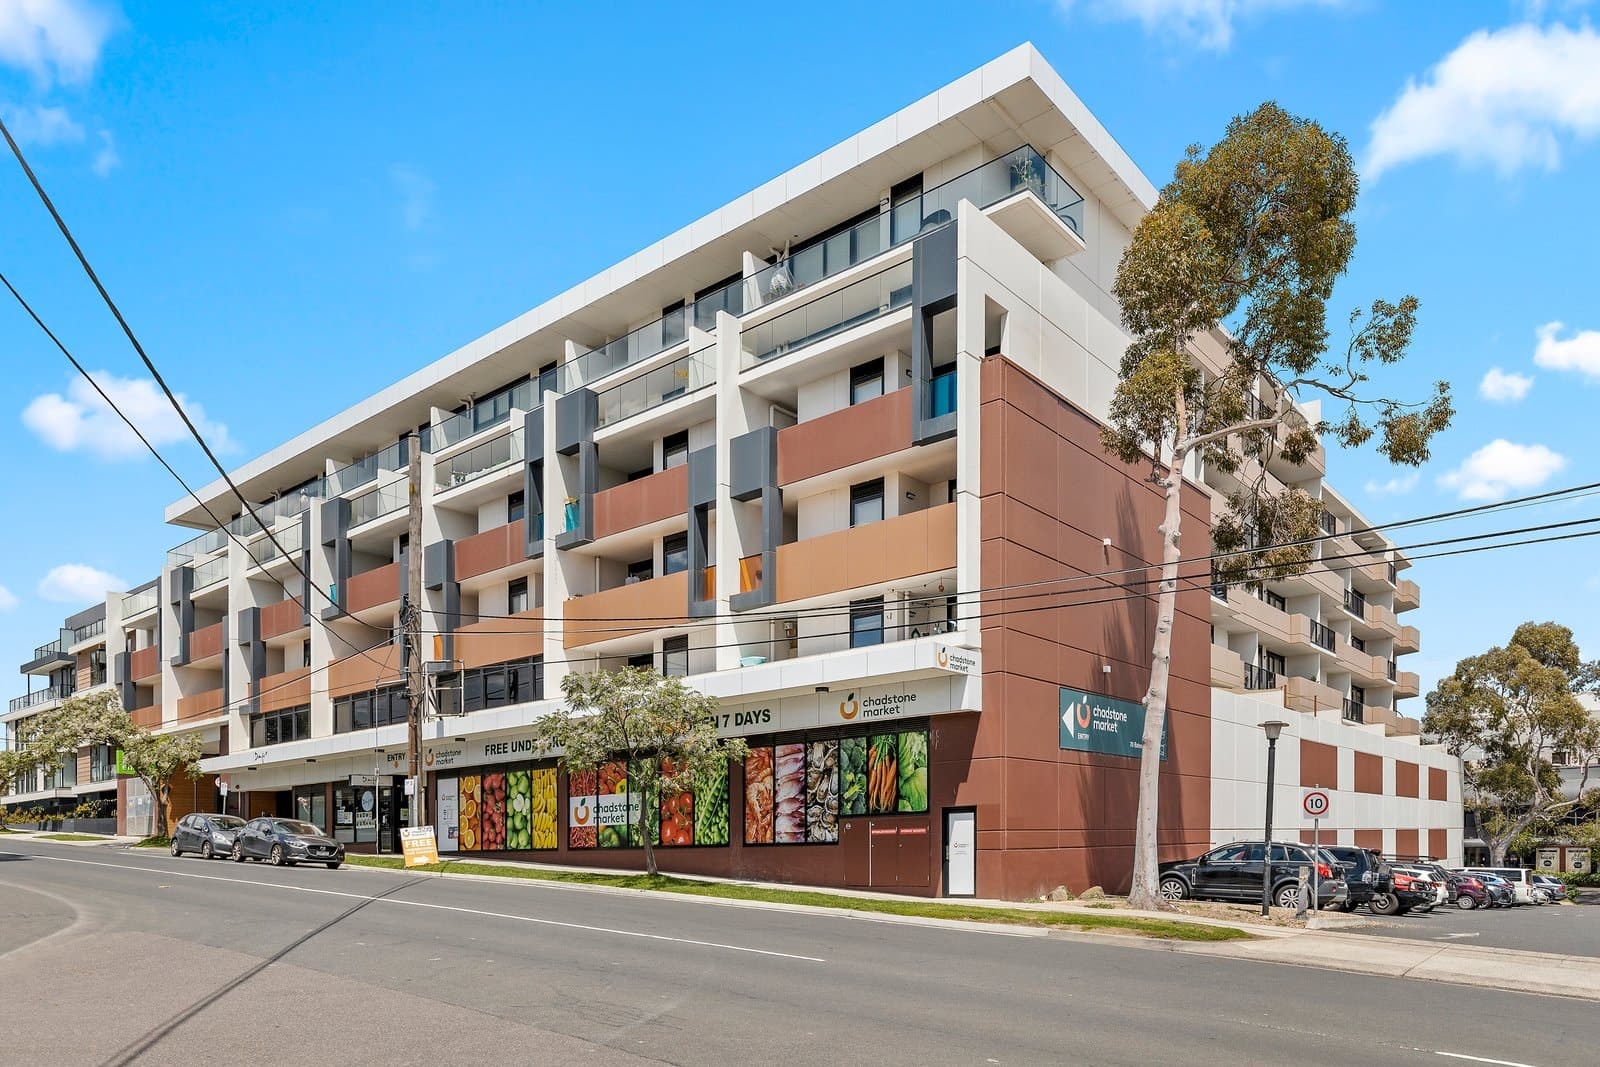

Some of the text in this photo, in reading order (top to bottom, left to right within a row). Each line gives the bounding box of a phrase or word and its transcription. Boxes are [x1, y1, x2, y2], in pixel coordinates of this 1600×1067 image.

[862, 694, 917, 707] chadstone
[863, 705, 901, 718] market
[1093, 704, 1128, 722] chadstone
[485, 742, 508, 756] FREE
[722, 714, 730, 728] 7
[735, 709, 771, 727] DAYS
[1093, 719, 1118, 733] market
[387, 752, 406, 762] ENTRY
[593, 802, 640, 814] chadstone
[1310, 798, 1323, 809] 10
[593, 813, 625, 824] market
